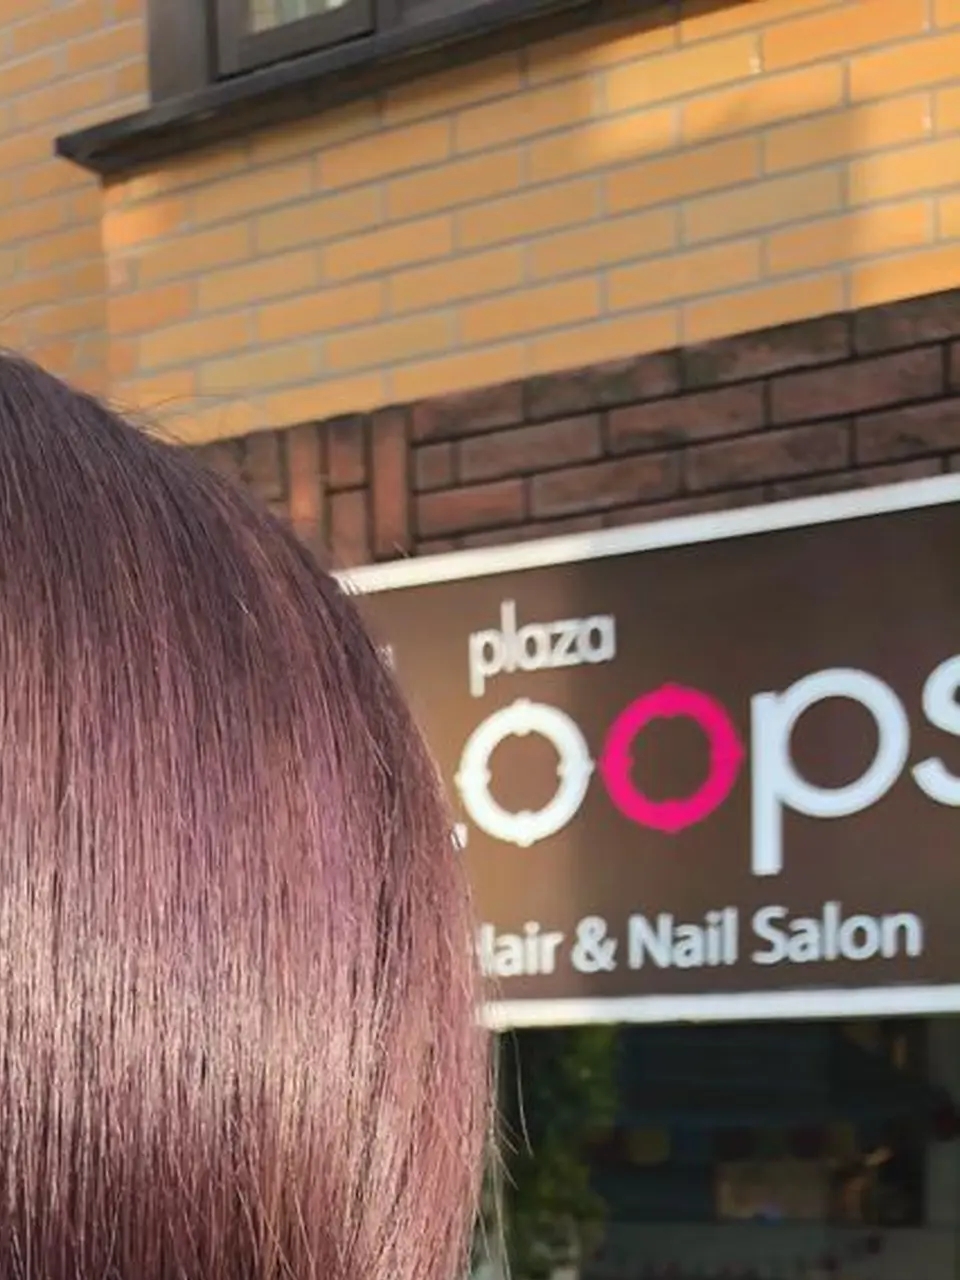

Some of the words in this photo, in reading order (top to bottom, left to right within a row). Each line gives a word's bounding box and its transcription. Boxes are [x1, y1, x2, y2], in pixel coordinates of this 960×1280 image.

[468, 600, 616, 698] plaza
[570, 915, 618, 973] &
[627, 906, 739, 970] Nail
[751, 901, 923, 965] Salon
